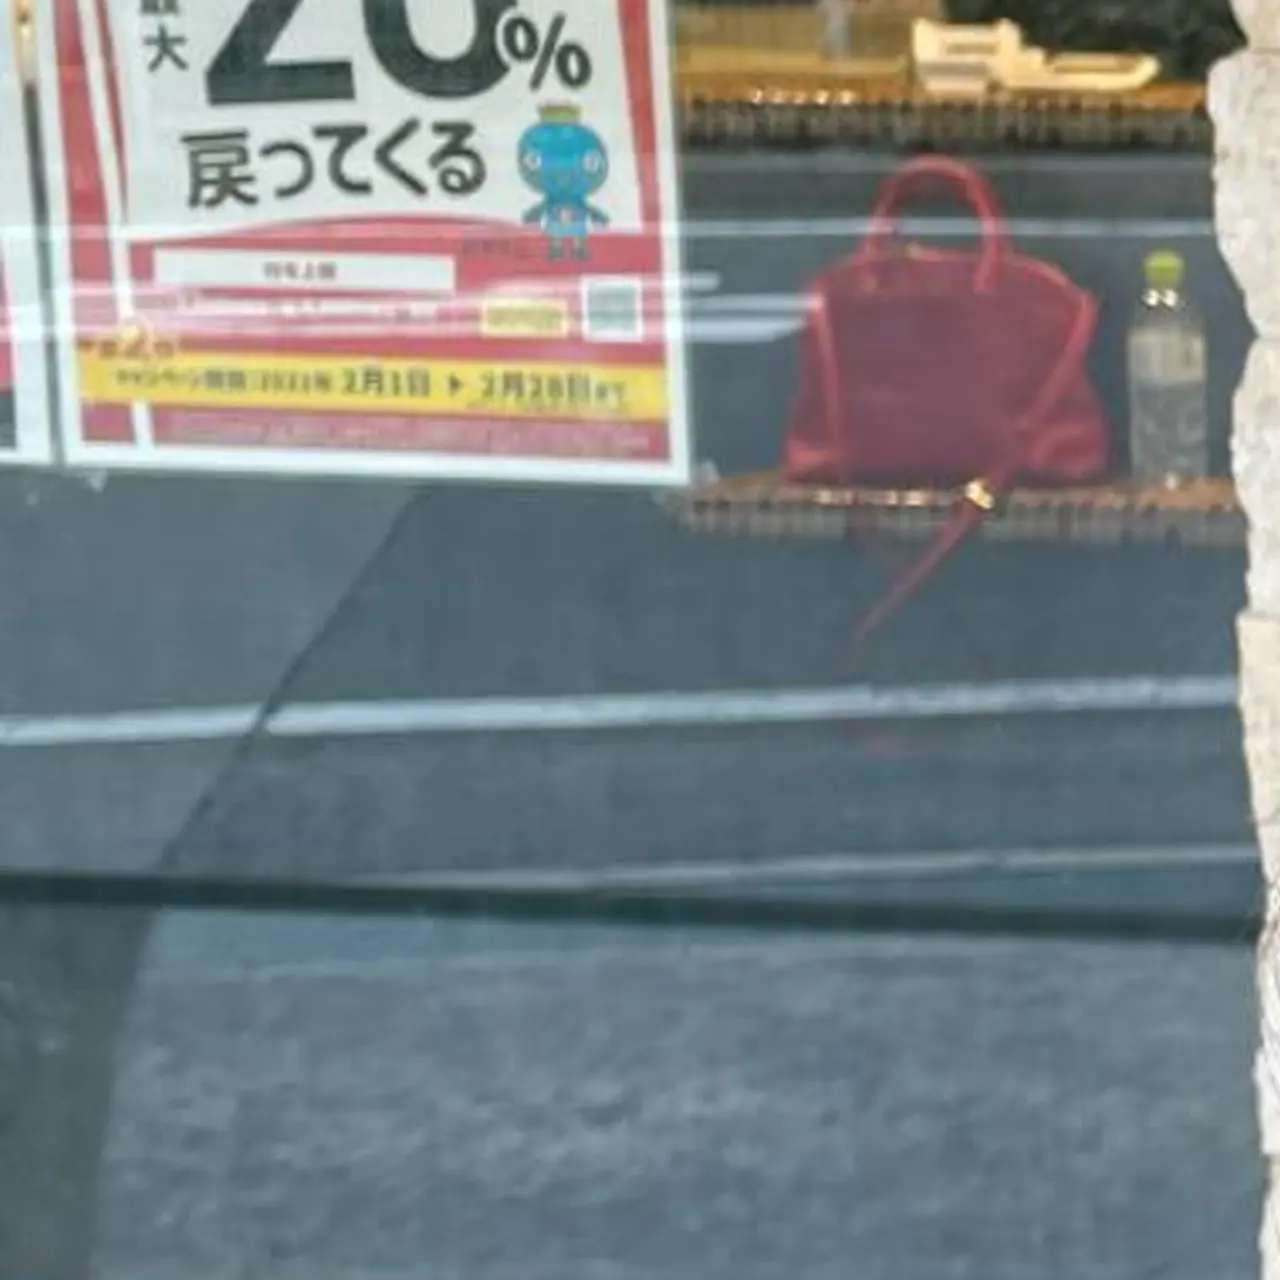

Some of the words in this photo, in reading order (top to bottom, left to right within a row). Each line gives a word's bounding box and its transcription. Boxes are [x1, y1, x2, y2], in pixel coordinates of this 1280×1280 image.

[179, 117, 487, 209] 戻ってくる
